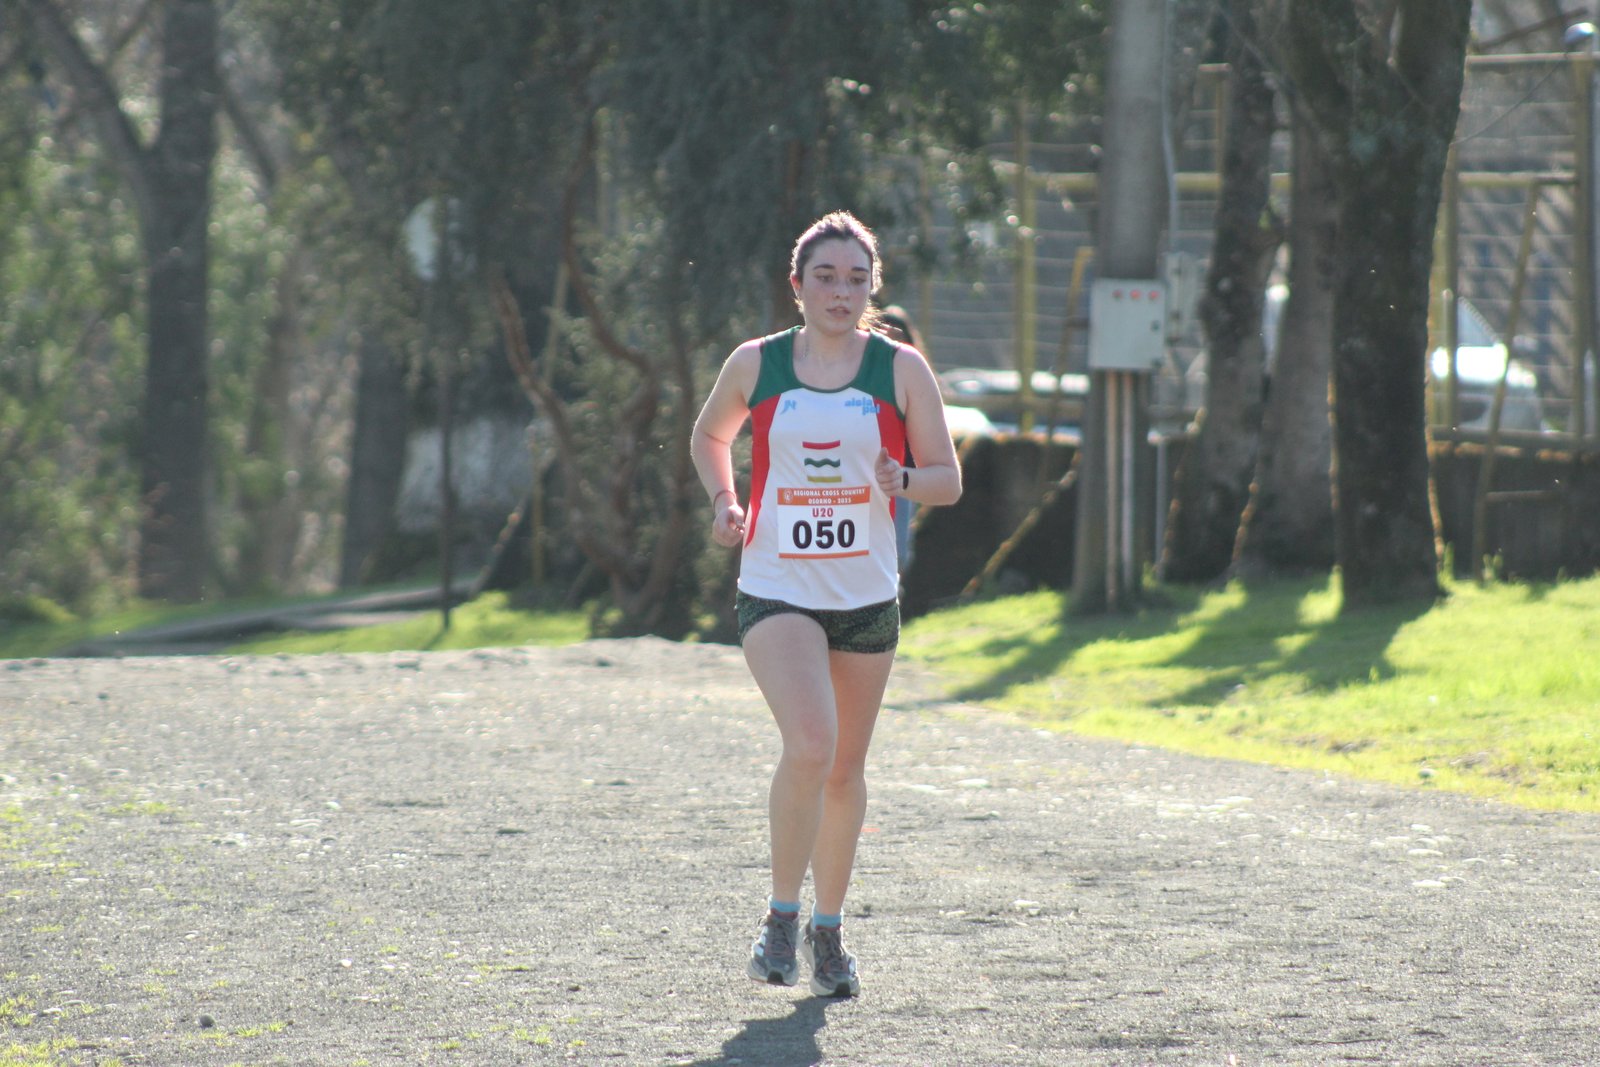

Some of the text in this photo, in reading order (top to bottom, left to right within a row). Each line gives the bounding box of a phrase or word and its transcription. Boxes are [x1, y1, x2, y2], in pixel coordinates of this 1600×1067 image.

[793, 487, 865, 497] REGIONAL CROSS COUNTRY
[808, 498, 832, 506] OSORNO
[812, 507, 834, 518] U20
[793, 519, 855, 549] 050
